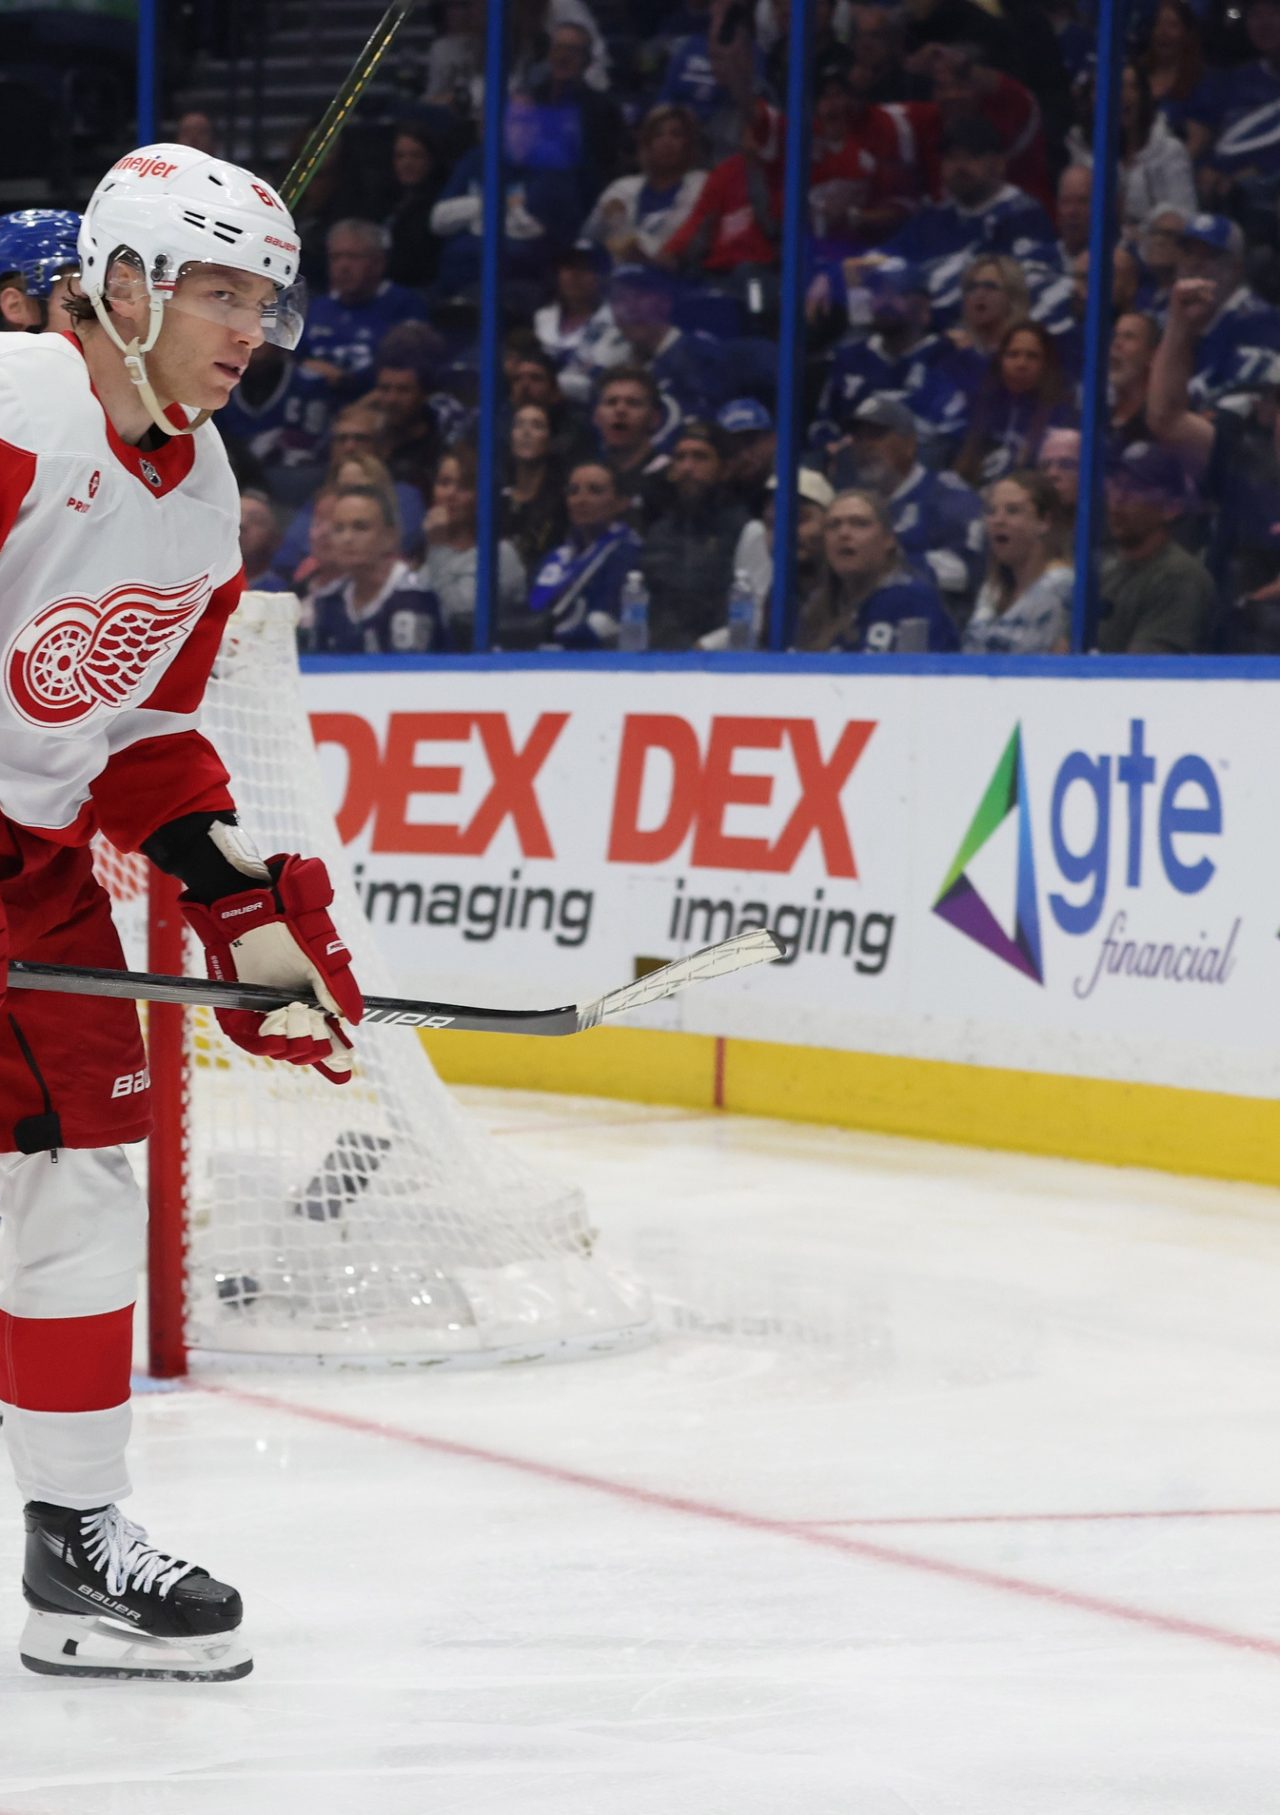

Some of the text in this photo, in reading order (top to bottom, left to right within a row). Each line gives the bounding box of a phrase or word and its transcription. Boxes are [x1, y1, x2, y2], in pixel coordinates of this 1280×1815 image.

[113, 155, 178, 179] meijer
[606, 713, 879, 881] DEX
[1047, 718, 1223, 937] gte
[669, 877, 895, 976] imaging
[1073, 910, 1242, 1000] financial
[78, 1584, 142, 1621] BAUER
